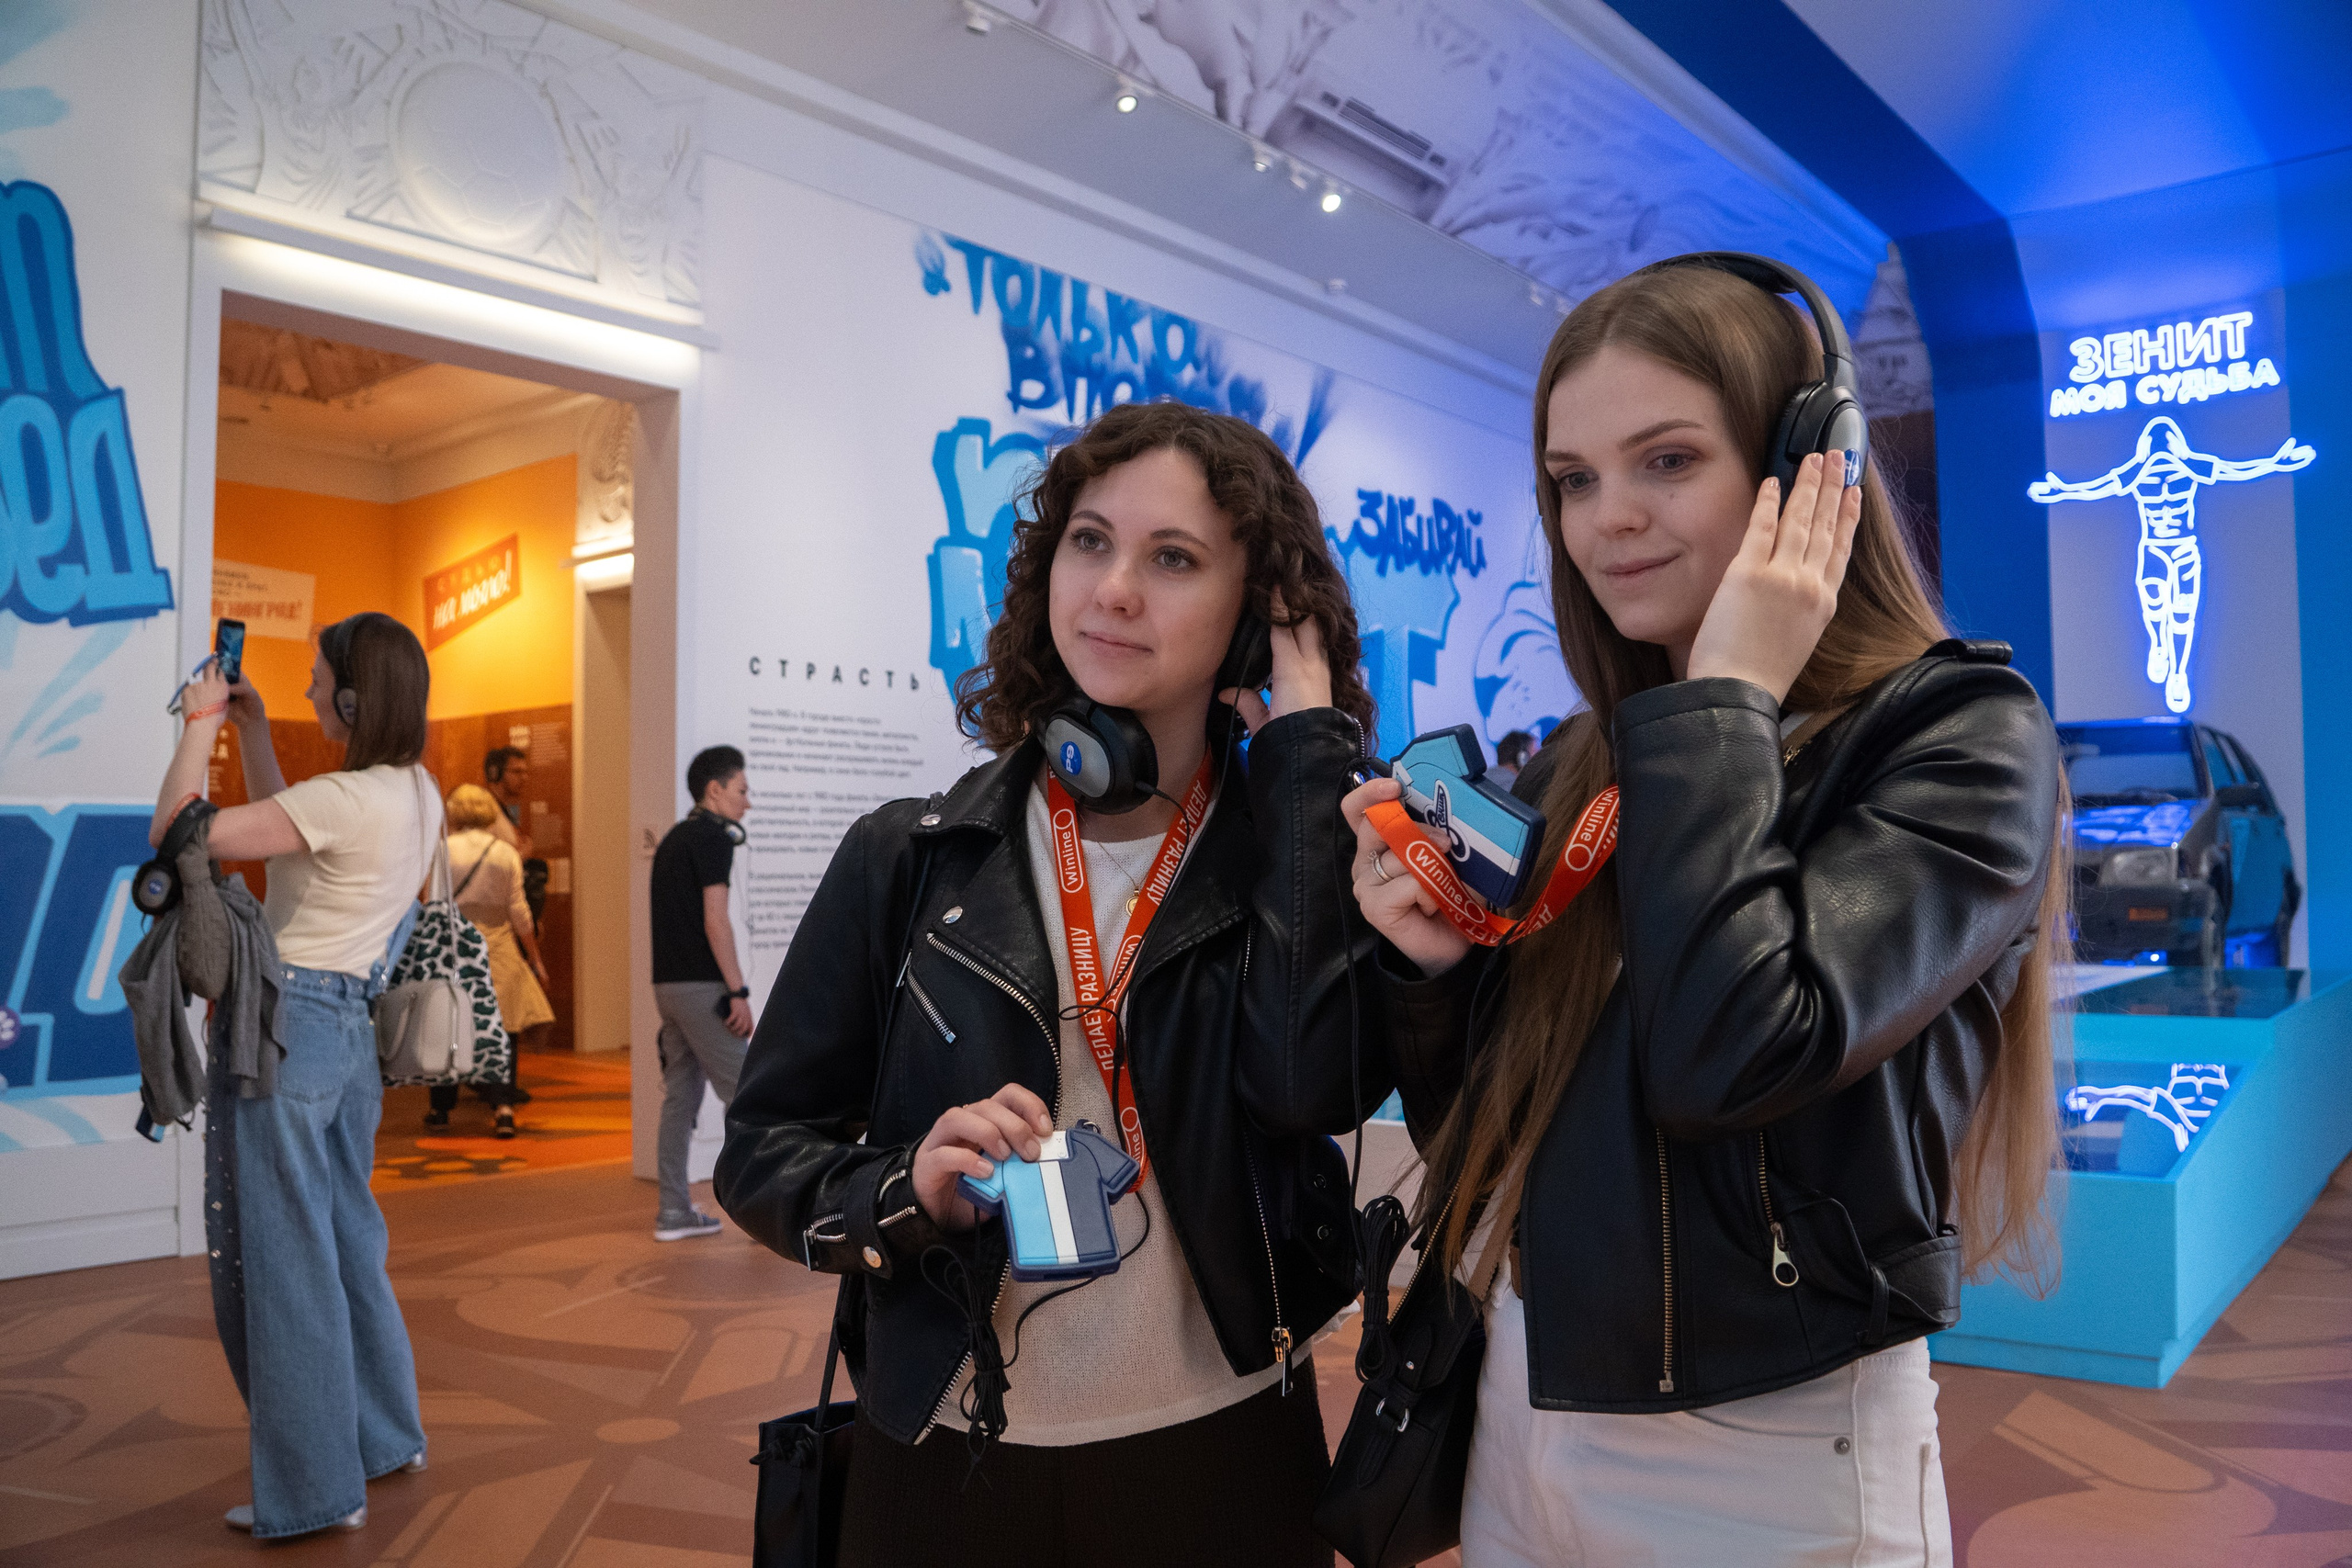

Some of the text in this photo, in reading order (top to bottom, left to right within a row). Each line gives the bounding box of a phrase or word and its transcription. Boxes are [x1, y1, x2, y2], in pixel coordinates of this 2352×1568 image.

[939, 231, 1199, 375] ТОЛЬКО
[2070, 311, 2253, 383] ЗЕНИТ
[2050, 358, 2280, 417] МОЯ СУДЬБА
[1357, 487, 1487, 578] ЗАБИРАЙ
[749, 656, 920, 691] СТРАСТЬ
[1065, 744, 1075, 773] P9
[1579, 790, 1614, 843] Winline
[1063, 830, 1078, 886] Winline
[1415, 847, 1464, 906] Winline
[1069, 926, 1097, 1002] РАЗНИЦУ
